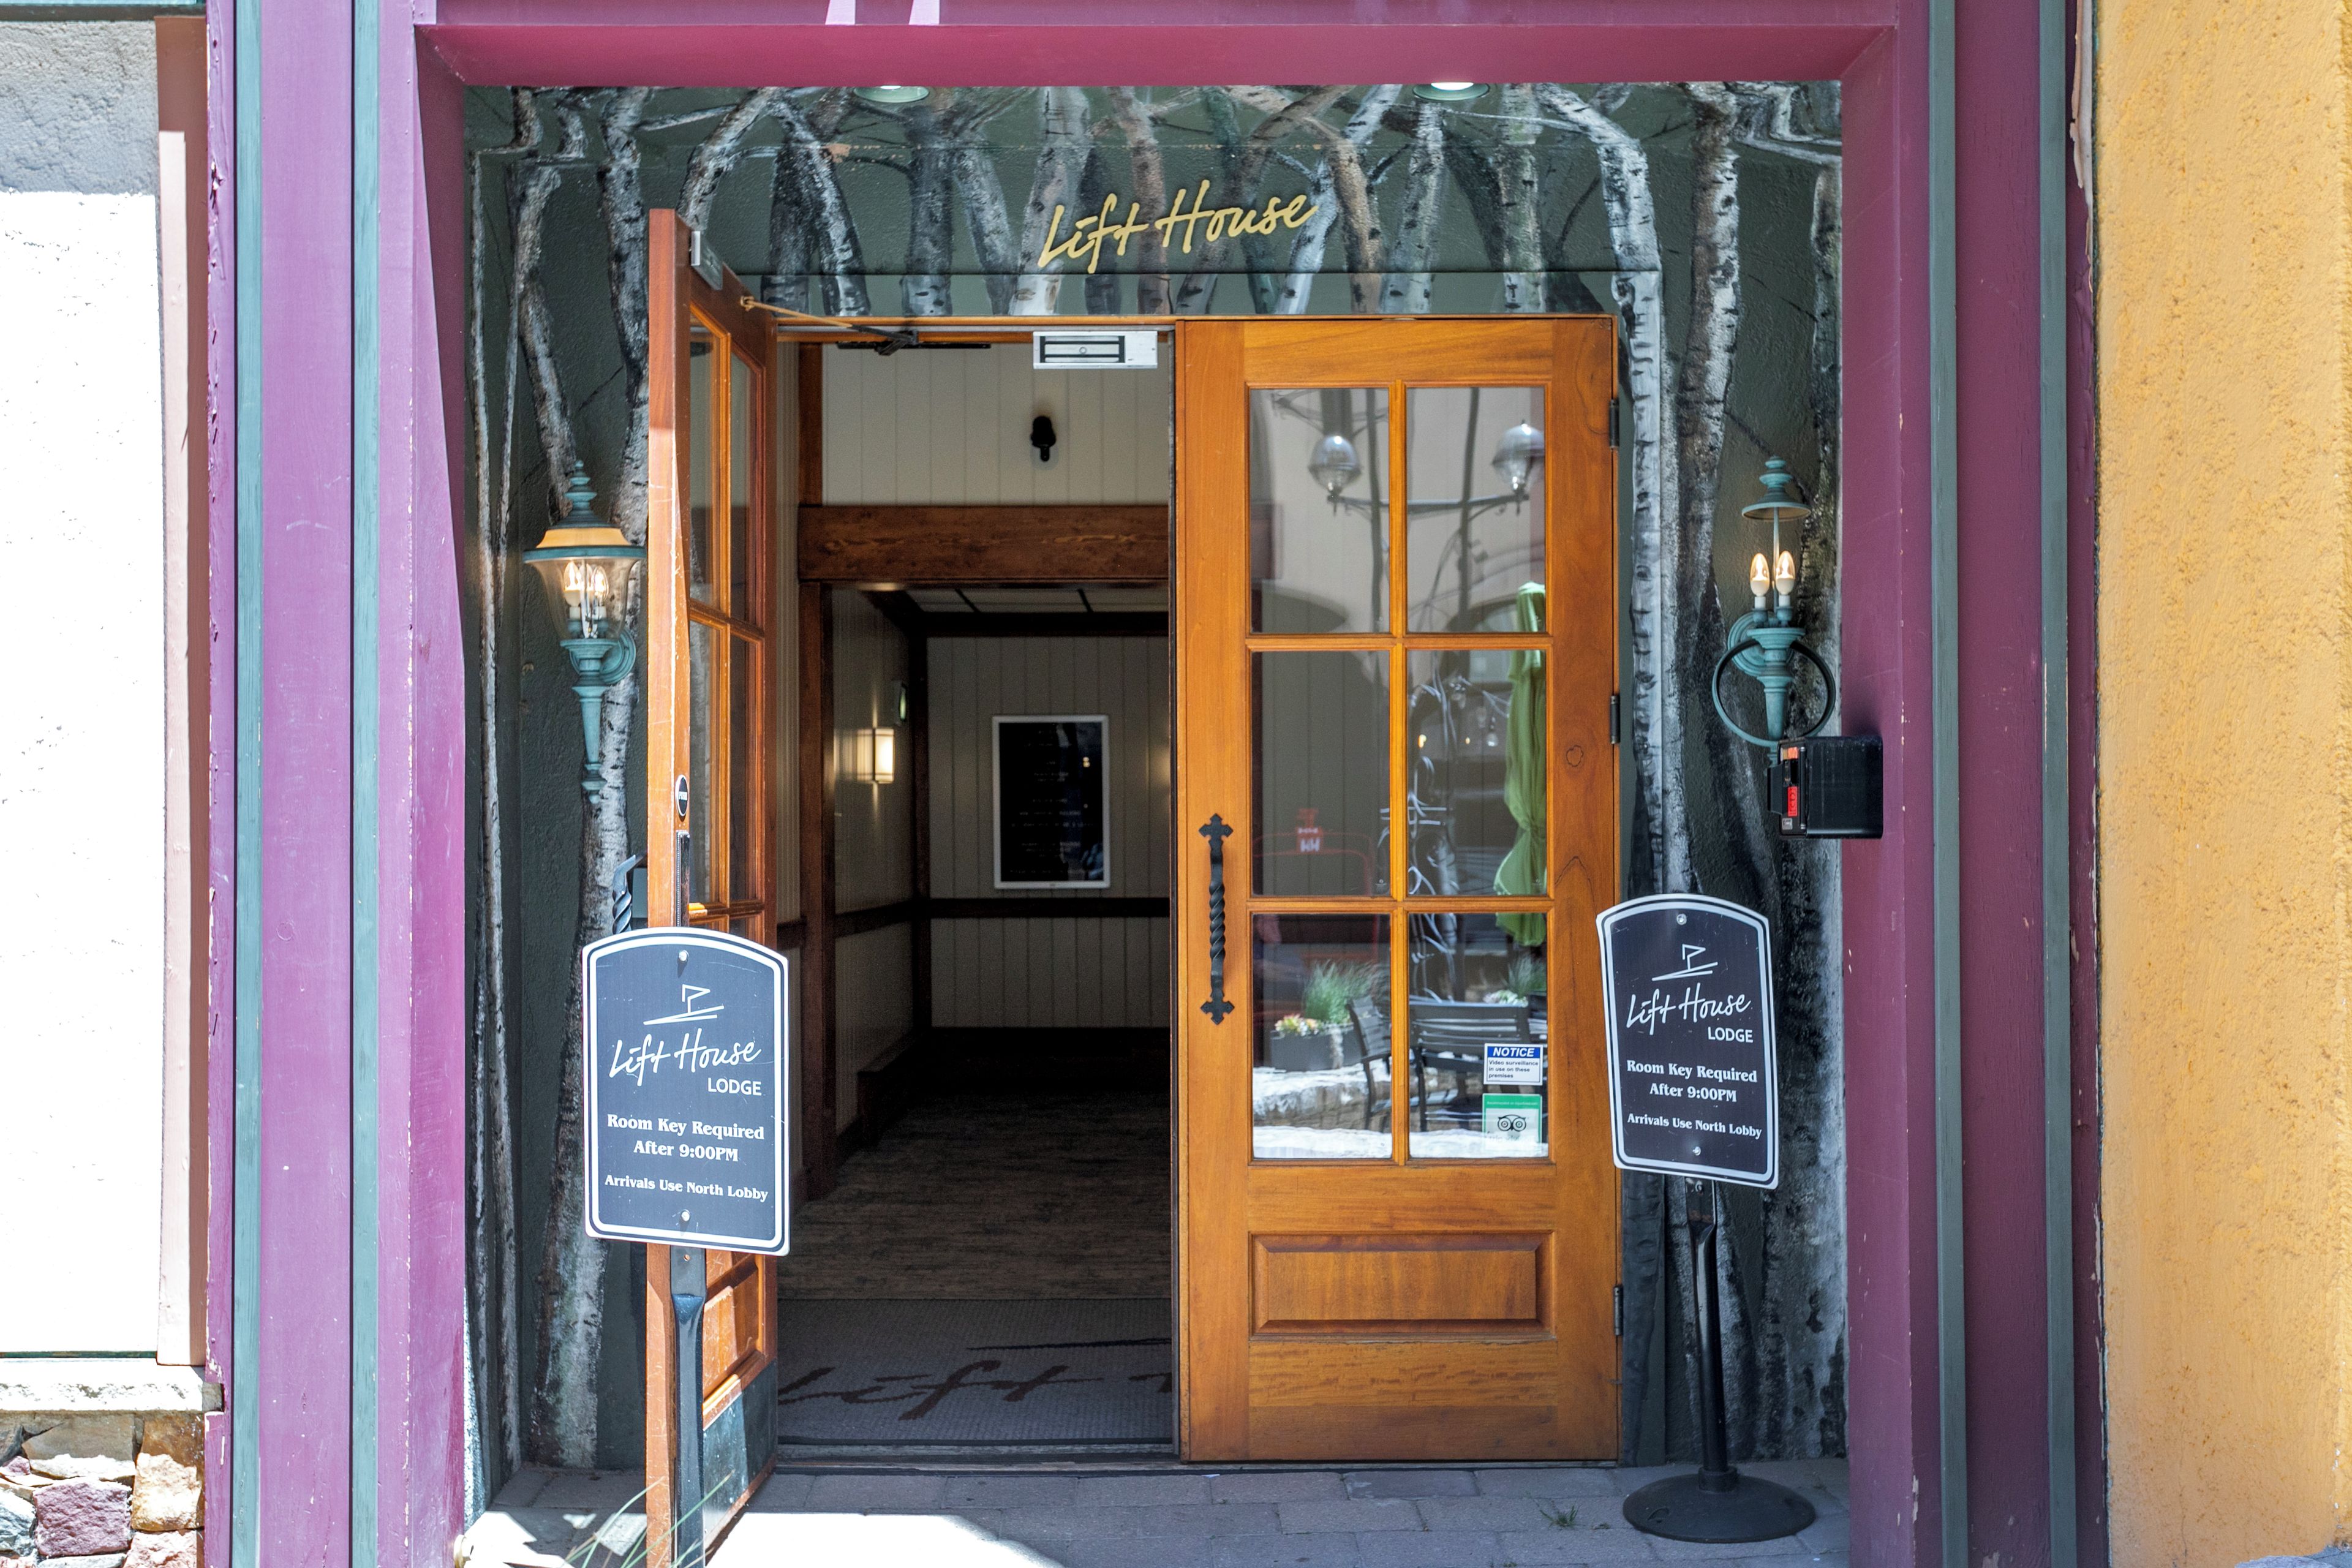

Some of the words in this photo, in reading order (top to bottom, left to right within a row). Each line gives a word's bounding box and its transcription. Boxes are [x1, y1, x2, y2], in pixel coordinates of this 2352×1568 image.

[1038, 193, 1148, 274] Lift
[1156, 179, 1317, 254] House
[1627, 989, 1676, 1035] Lift
[1679, 982, 1751, 1022] House
[1708, 1027, 1753, 1042] LODGE
[609, 1034, 671, 1086] Lift
[674, 1028, 761, 1072] House
[1493, 1047, 1535, 1057] NOTICE
[1627, 1060, 1664, 1074] Room
[1669, 1063, 1692, 1079] Key
[1697, 1066, 1757, 1082] Required
[708, 1078, 761, 1095] LODGE
[1650, 1083, 1683, 1096] After
[1687, 1087, 1736, 1102] 9:00PM
[608, 1114, 652, 1130] Room
[658, 1118, 687, 1136] Key
[692, 1121, 764, 1140] Required
[1627, 1114, 1669, 1126] Arrivals
[1673, 1118, 1692, 1129] Use
[1695, 1120, 1725, 1133] North
[1729, 1124, 1762, 1139] Lobby
[633, 1140, 674, 1156] After
[679, 1144, 738, 1161] 9:00PM
[605, 1175, 655, 1189] Arrivals
[660, 1180, 683, 1191] Use
[687, 1182, 723, 1196] North
[728, 1186, 768, 1202] Lobby
